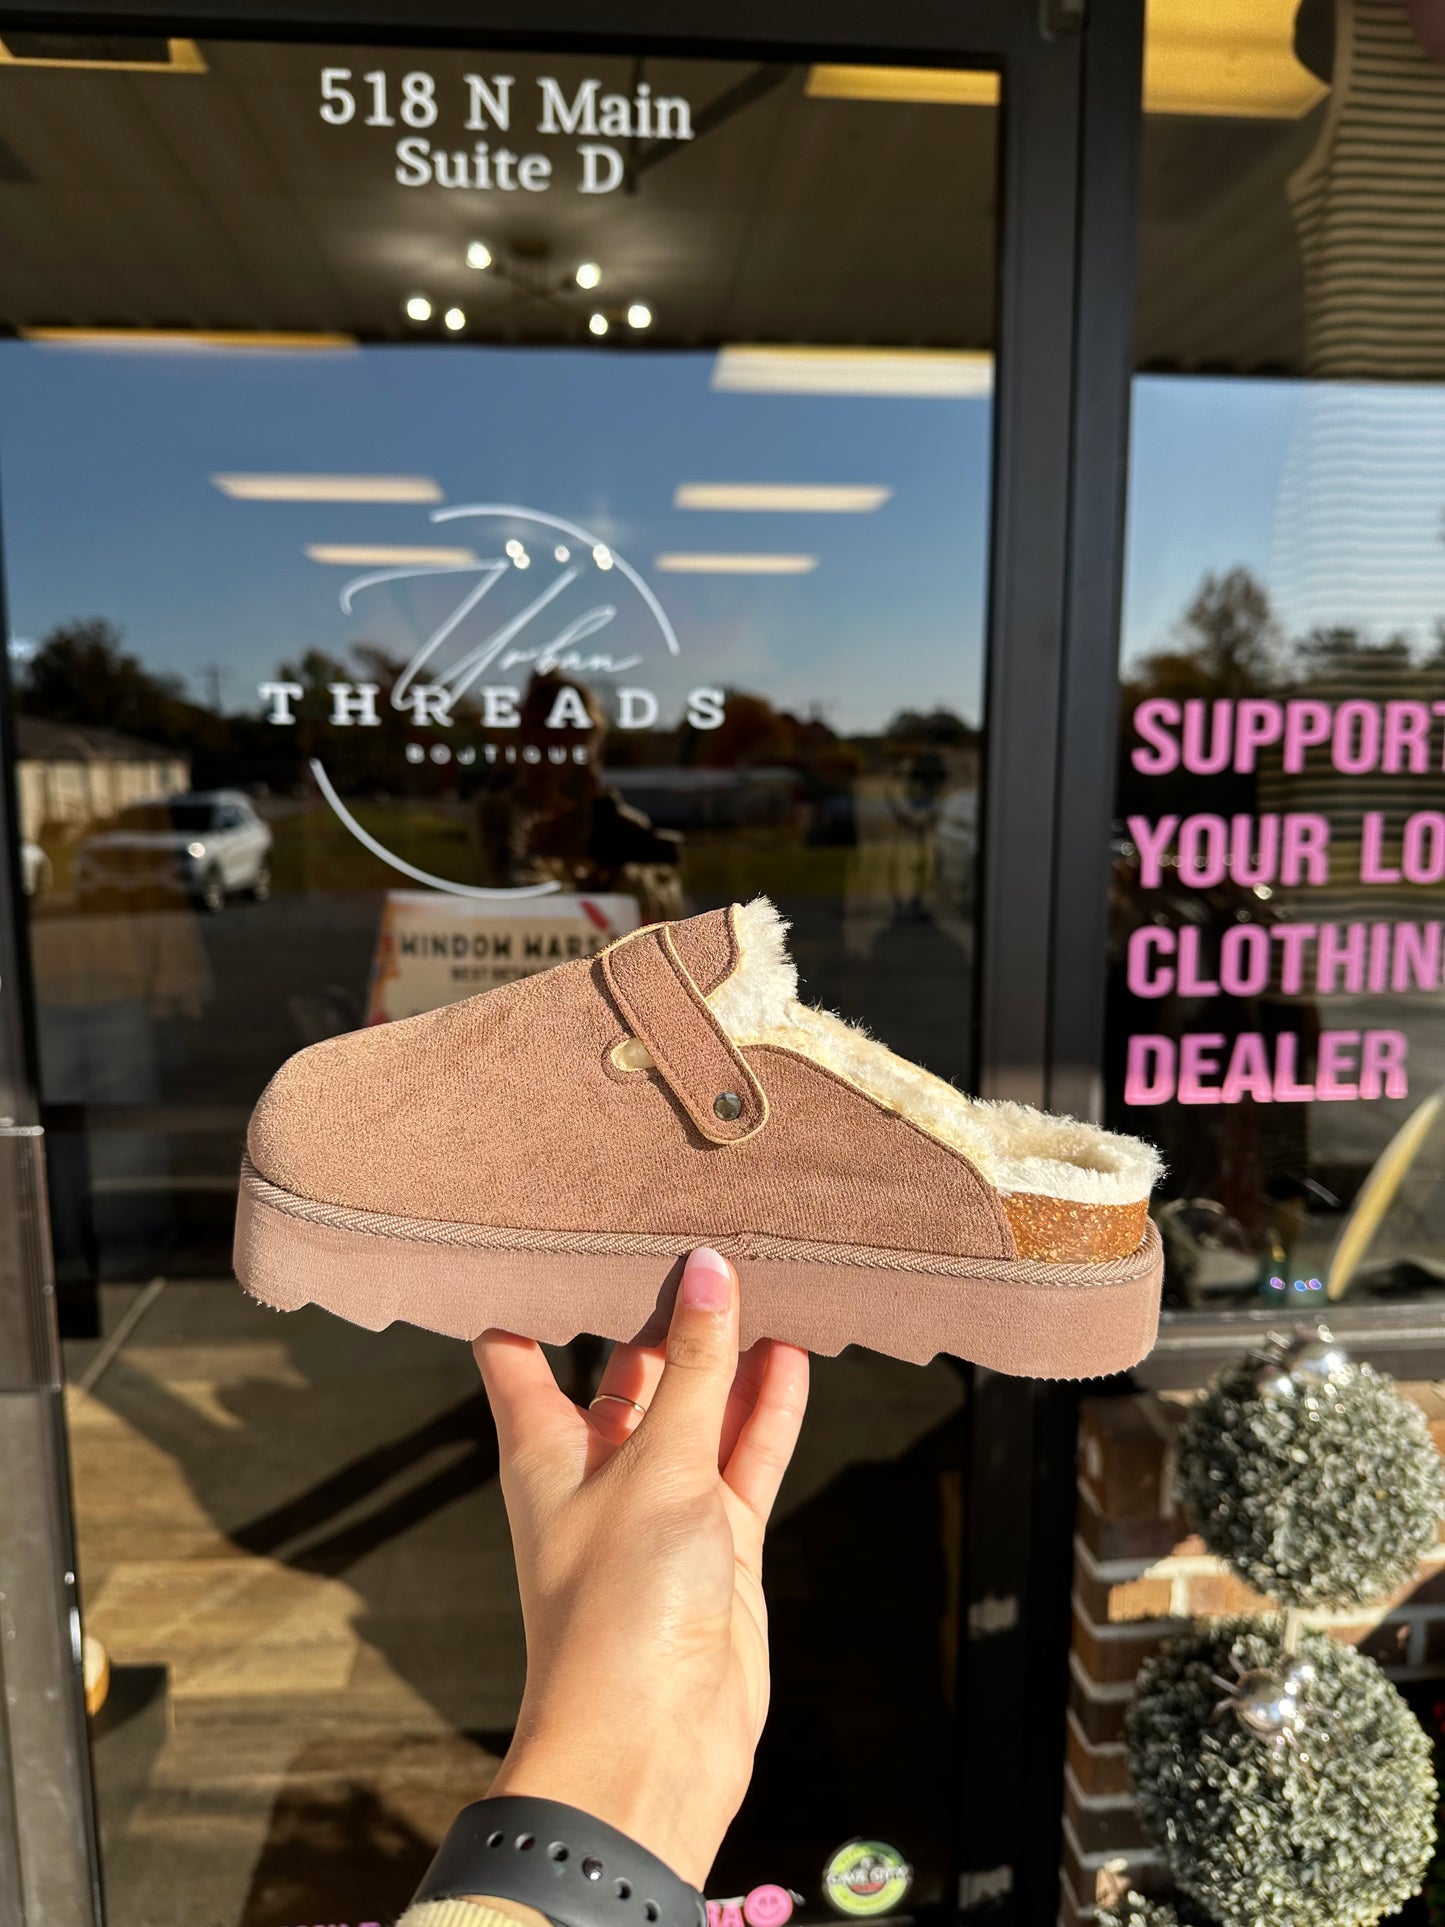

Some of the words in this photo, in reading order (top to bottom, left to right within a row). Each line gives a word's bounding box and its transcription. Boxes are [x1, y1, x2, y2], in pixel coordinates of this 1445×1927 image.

[319, 67, 438, 129] 518
[463, 73, 516, 132] N
[536, 76, 695, 140] Main
[395, 136, 553, 192] Suite
[576, 143, 625, 194] D
[339, 557, 645, 712] Urban
[257, 681, 727, 731] THREADS
[1131, 699, 1445, 776] SUPPOR
[405, 742, 590, 766] BOUTIQUE
[1127, 812, 1330, 889] YOUR
[1127, 920, 1445, 999] CLOTHIN
[1124, 1030, 1409, 1106] DEALER
